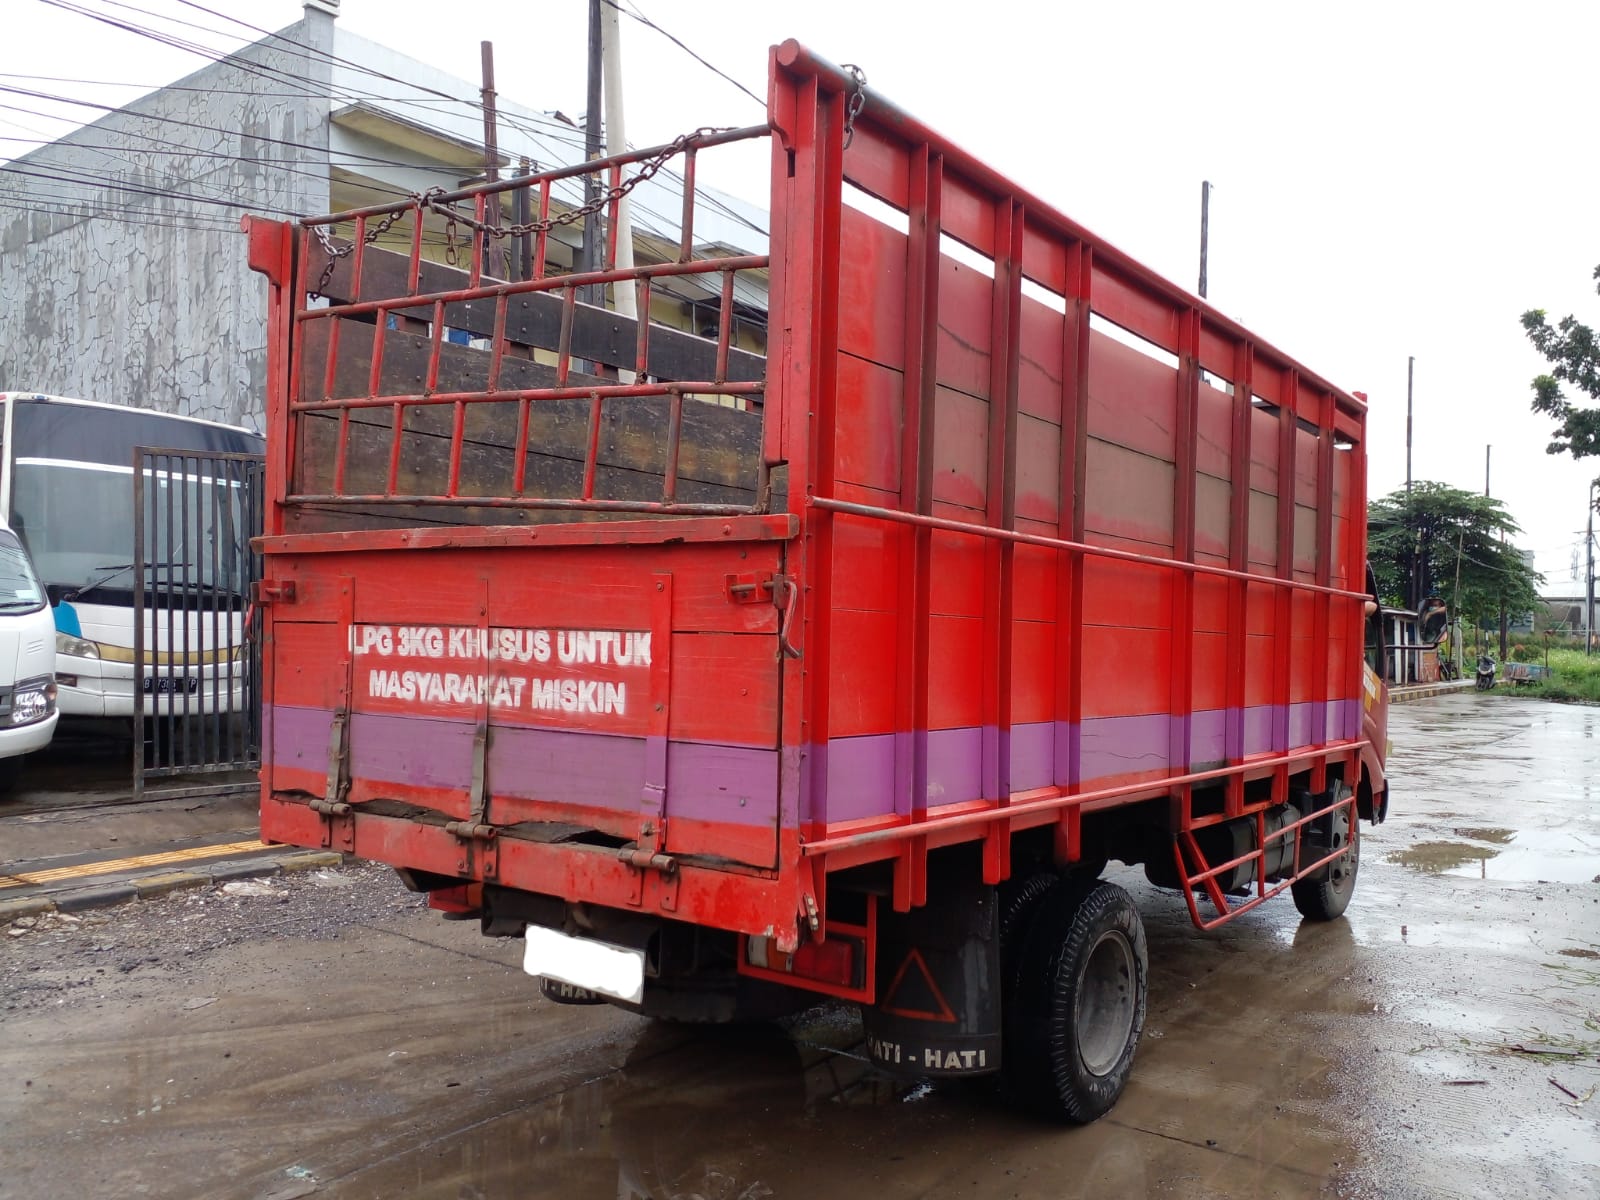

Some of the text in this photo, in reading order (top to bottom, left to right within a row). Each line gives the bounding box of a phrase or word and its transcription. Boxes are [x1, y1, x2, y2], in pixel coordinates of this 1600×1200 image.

[348, 624, 652, 666] LPG 3KG KHUSUS UNTUK
[369, 669, 626, 715] MASYARAKAT MISKIN
[924, 1048, 986, 1069] HATI
